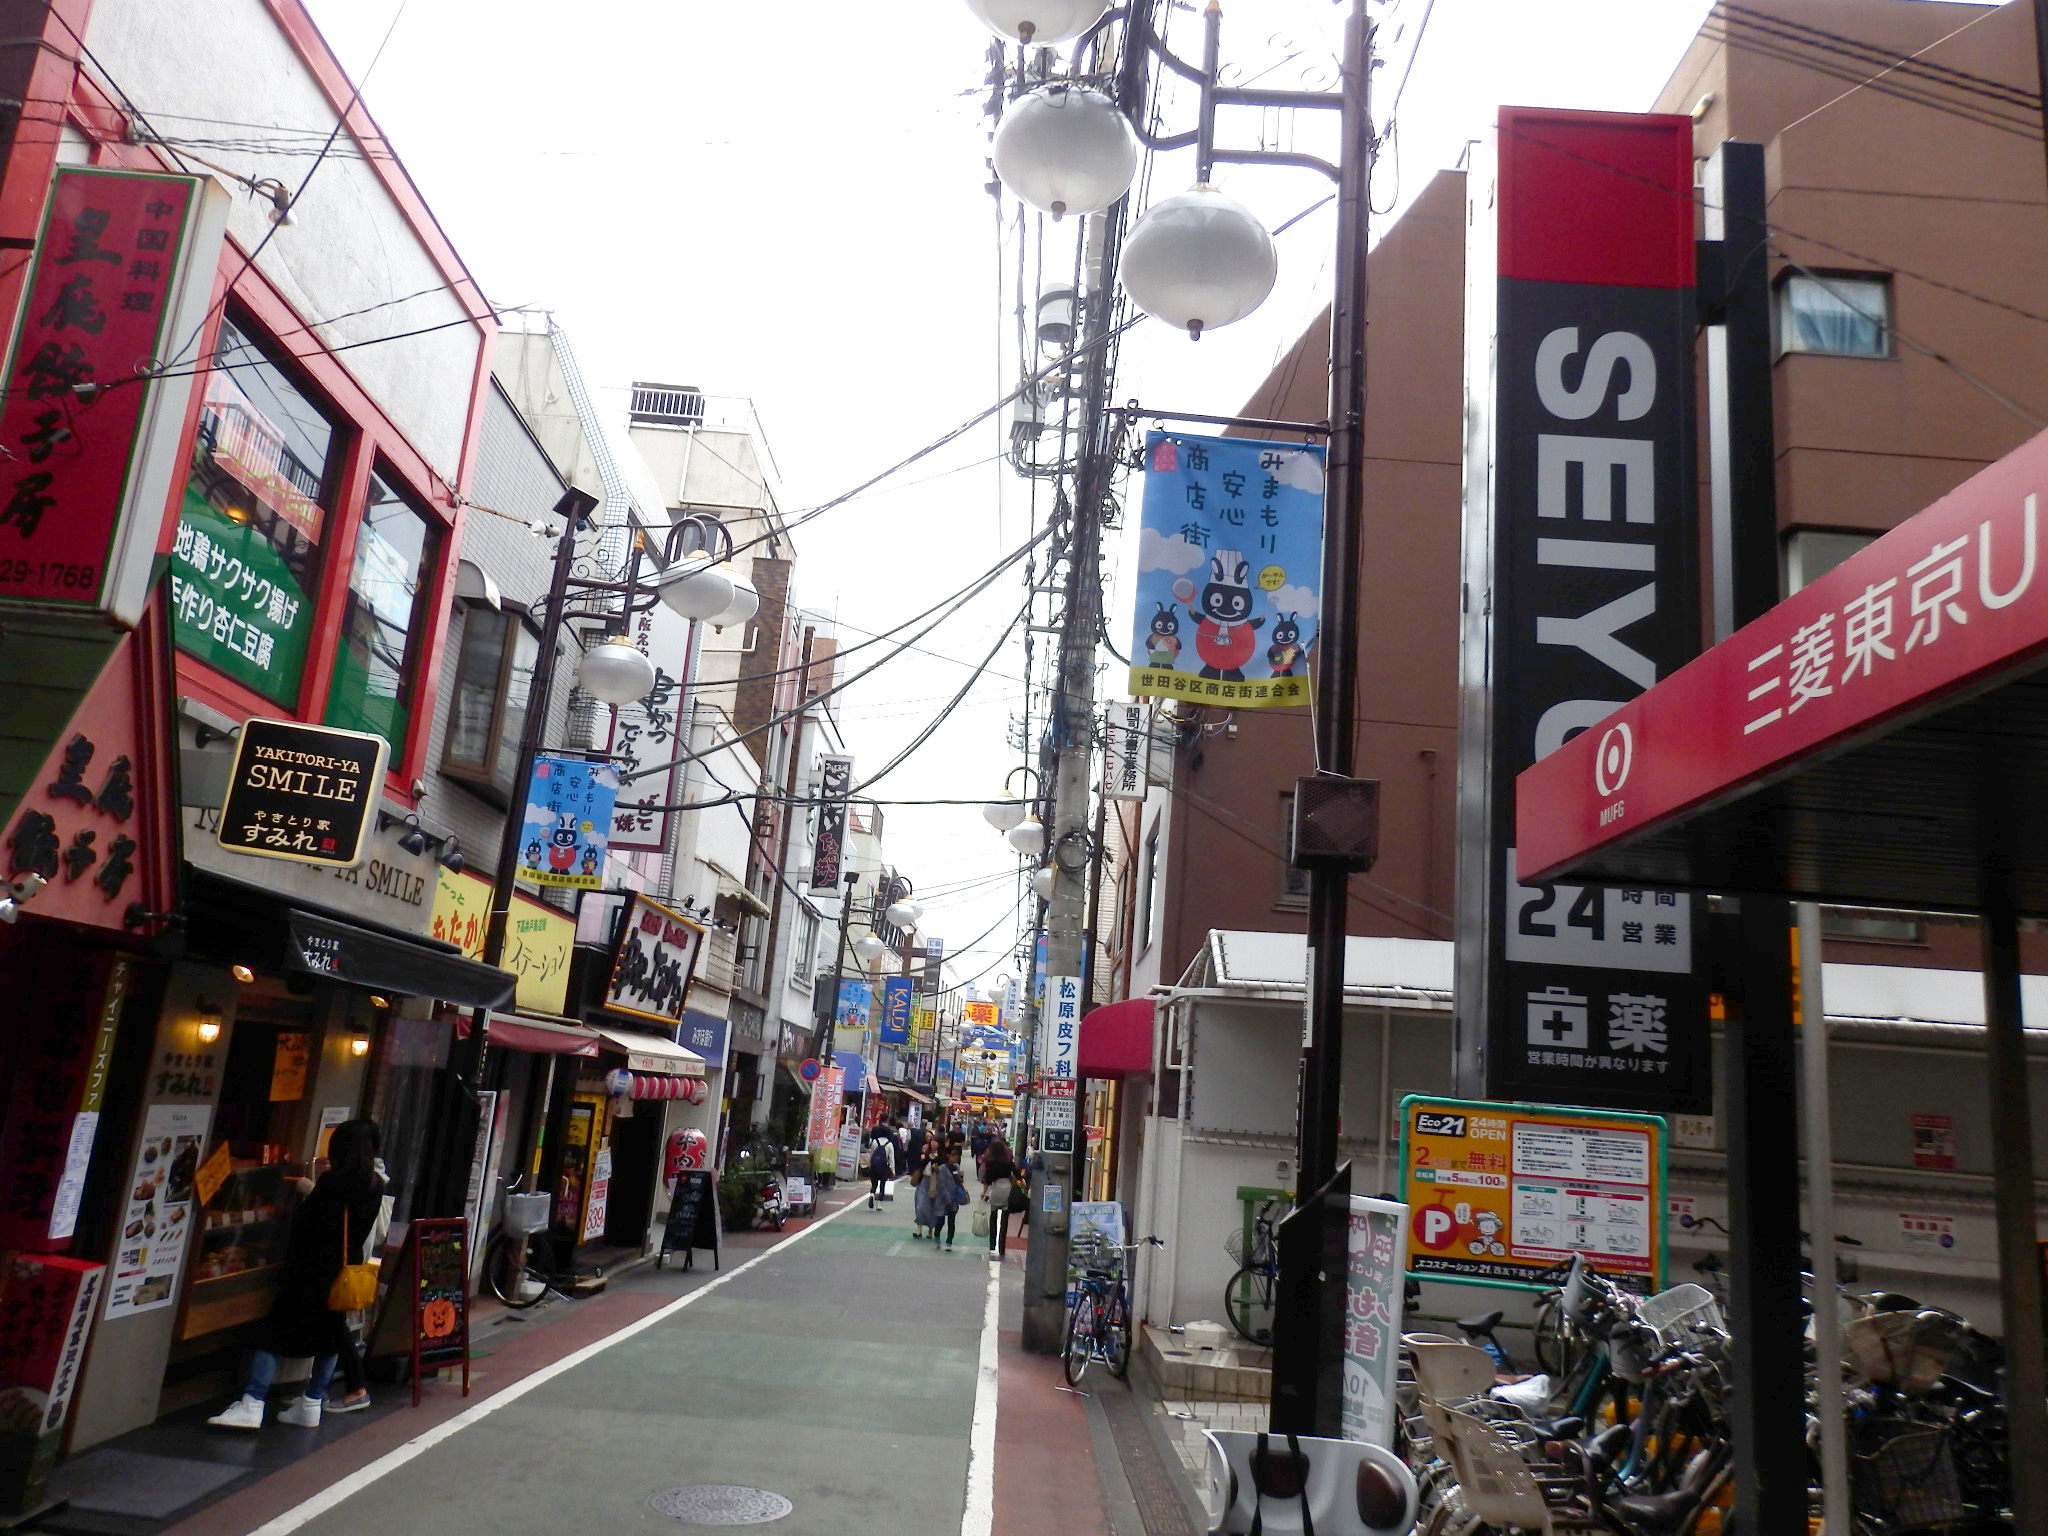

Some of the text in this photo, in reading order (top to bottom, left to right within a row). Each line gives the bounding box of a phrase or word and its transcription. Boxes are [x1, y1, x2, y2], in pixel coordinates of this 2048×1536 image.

[120, 200, 175, 312] 中国料理
[1179, 446, 1212, 550] 商店街
[1219, 470, 1247, 527] 安心
[1260, 451, 1285, 554] みまもり
[172, 519, 299, 630] 地鶏サクサク揚げ
[1744, 493, 2037, 735] 三菱東京U
[1140, 672, 1300, 698] 世田谷区商店街連合会
[255, 745, 361, 774] YAKITORI-YA
[247, 764, 358, 802] SMILE
[566, 776, 582, 802] 安心
[1600, 800, 1625, 827] MUFG
[243, 823, 318, 851] すみれ
[366, 859, 425, 907] SMILE
[1518, 884, 1605, 941] 24
[1621, 921, 1677, 946] 営業
[303, 949, 333, 971] すみれ
[891, 987, 909, 1033] KALDI
[1055, 981, 1076, 1078] 松原皮フ科
[1607, 992, 1669, 1054] 薬
[88, 961, 128, 1110] チャイニーズファ
[1527, 1050, 1669, 1074] 営業時間が異なります
[1419, 1114, 1465, 1135] Eco 21
[1470, 1128, 1507, 1140] OPEN
[1425, 1210, 1451, 1245] P
